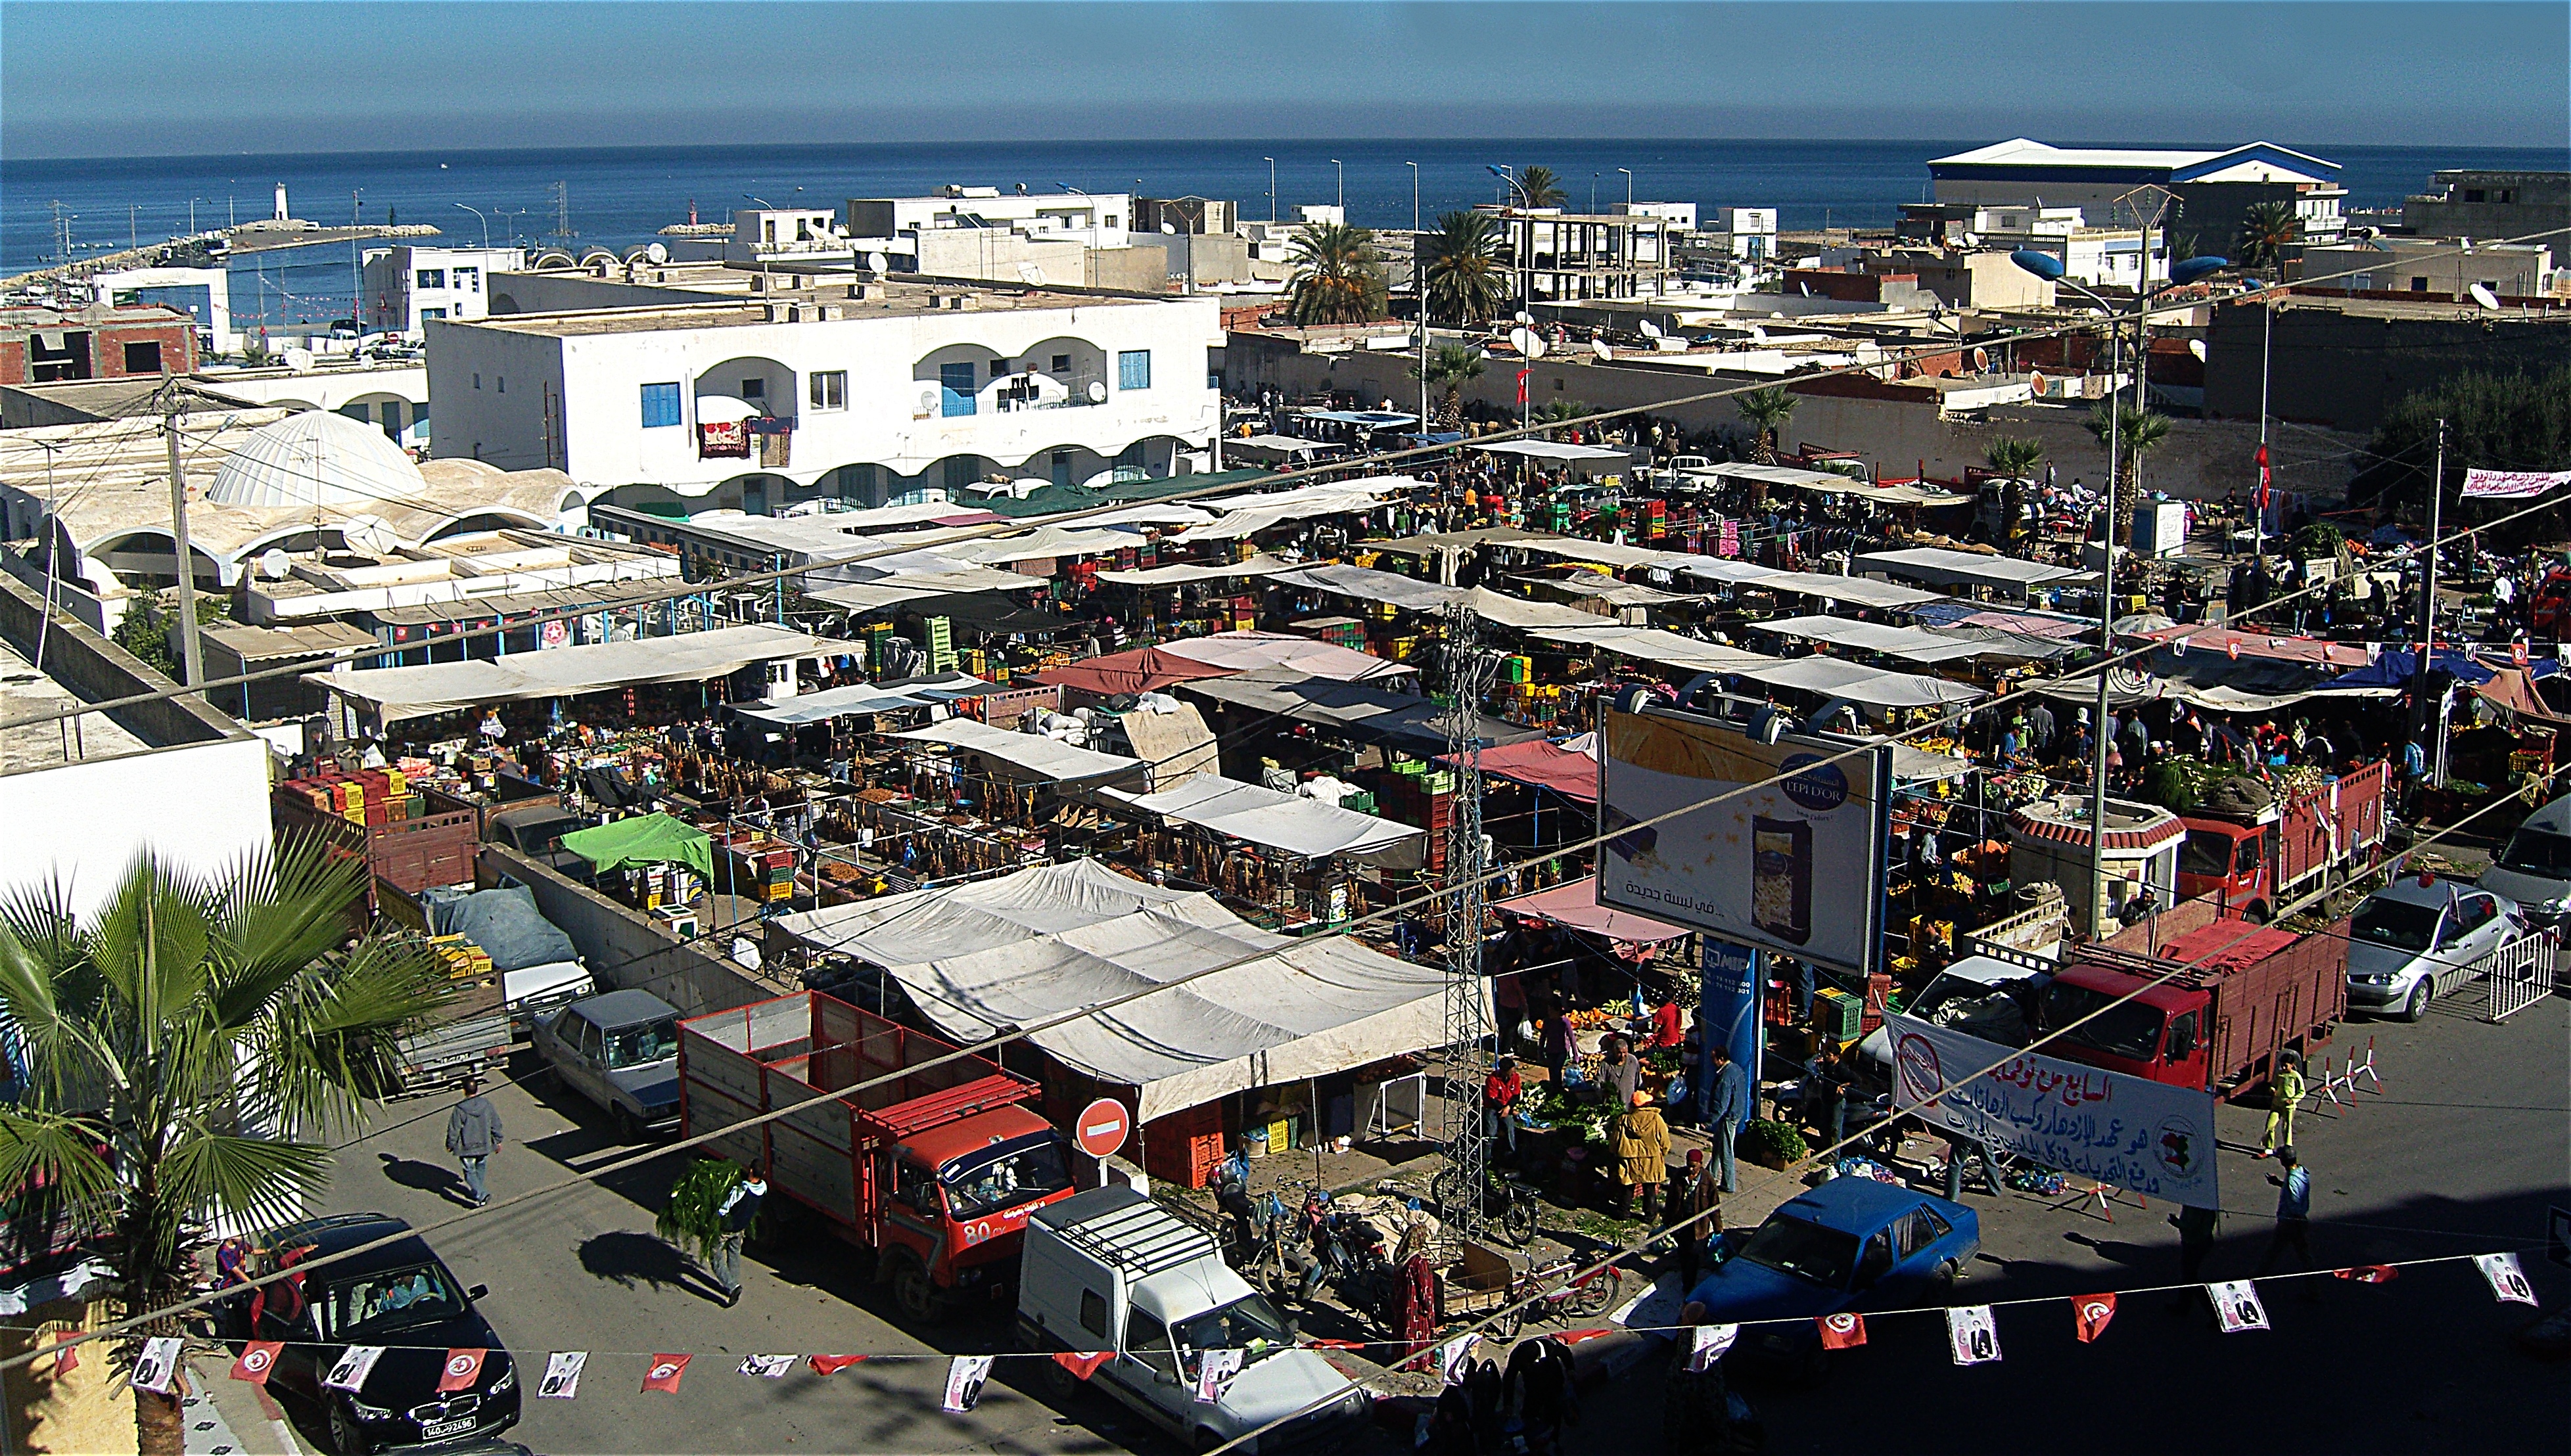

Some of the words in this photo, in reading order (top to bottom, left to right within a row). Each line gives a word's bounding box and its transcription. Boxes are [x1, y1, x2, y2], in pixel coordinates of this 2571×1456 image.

[1812, 786, 1840, 801] D'OR
[1626, 880, 1661, 902] جديدة
[1664, 889, 1692, 910] لبسة
[1987, 1057, 2036, 1088] نوفمبر
[2037, 1069, 2063, 1092] من
[2062, 1072, 2112, 1106] السابع
[1947, 1084, 2009, 1120] الرهانات
[2093, 1118, 2123, 1148] عهد
[2124, 1128, 2148, 1156] هو
[964, 1221, 990, 1244] 80
[427, 1426, 441, 1436] 140
